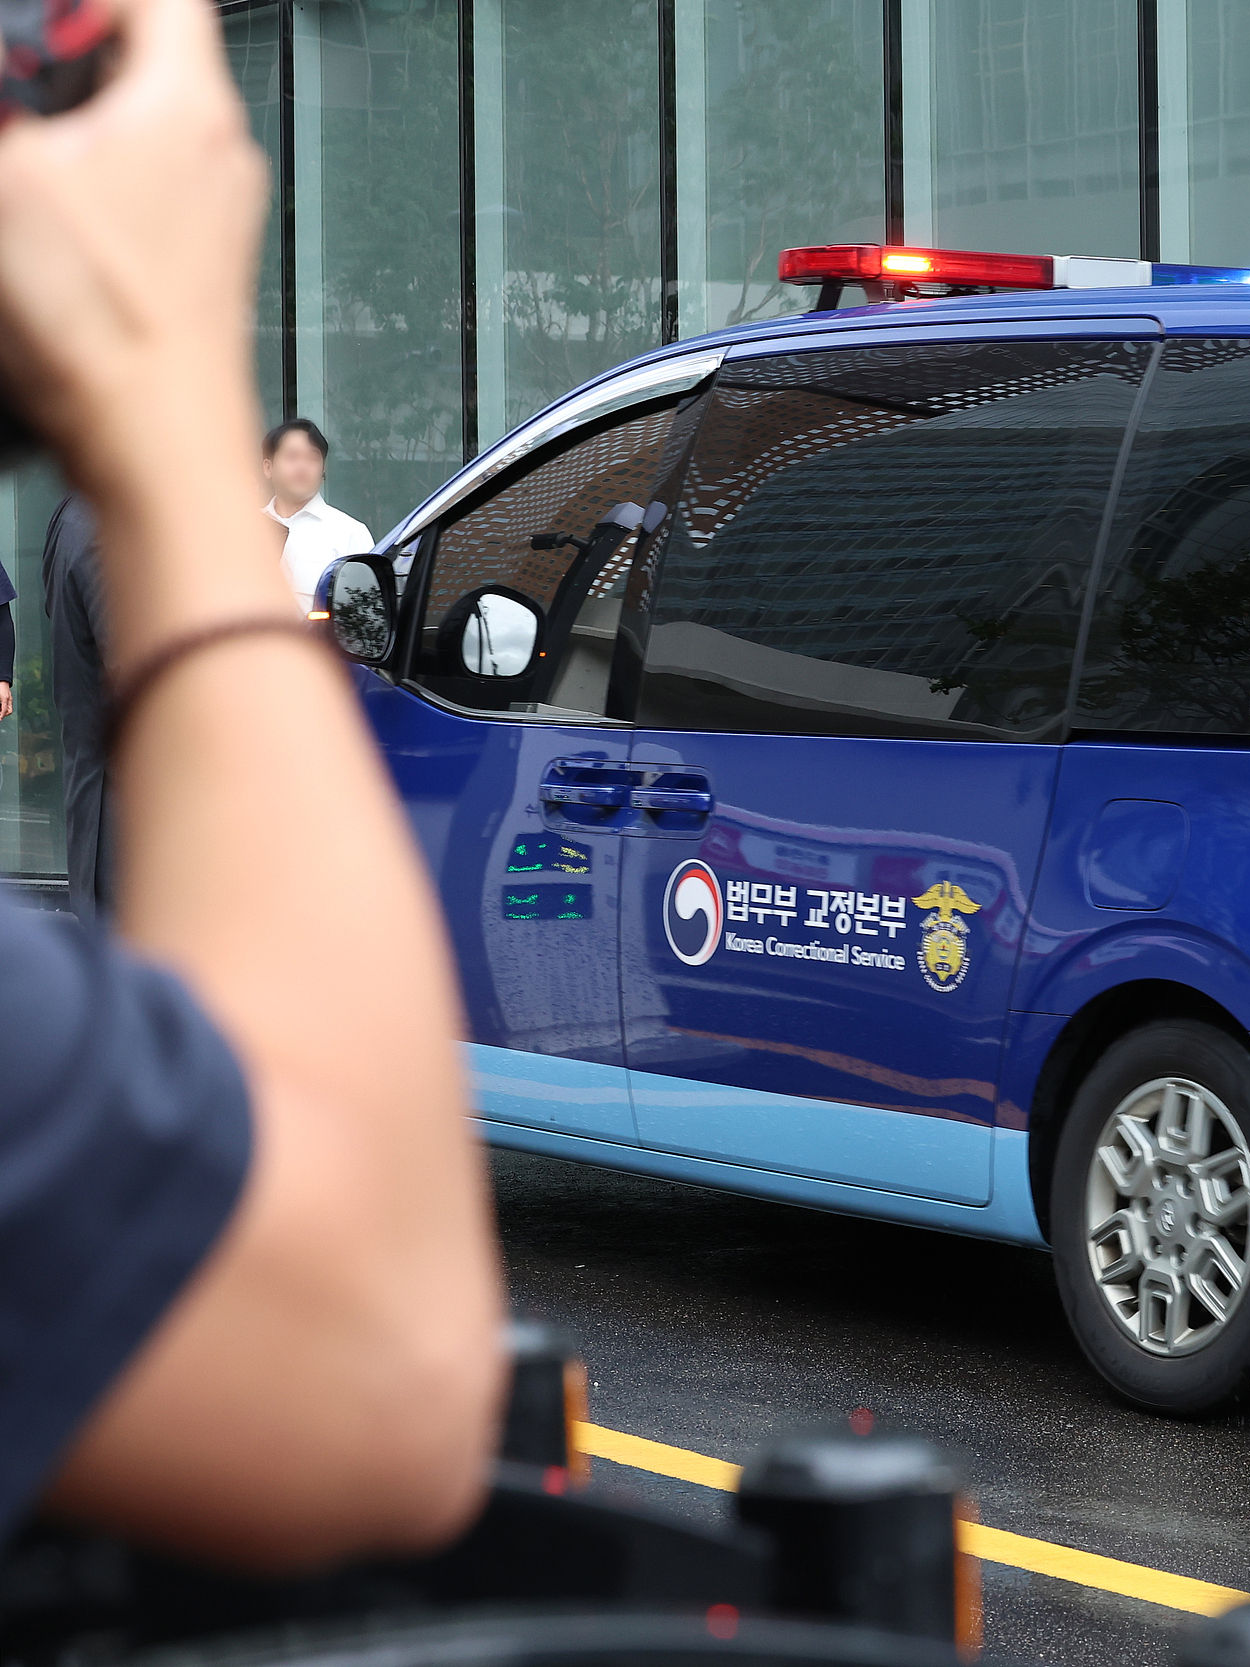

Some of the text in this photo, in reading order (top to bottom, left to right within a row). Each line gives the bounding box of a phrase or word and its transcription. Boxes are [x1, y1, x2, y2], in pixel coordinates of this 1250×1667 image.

[725, 880, 798, 927] 법무부
[803, 888, 907, 938] 교정본부
[725, 931, 906, 971] Korea Correctional Service
